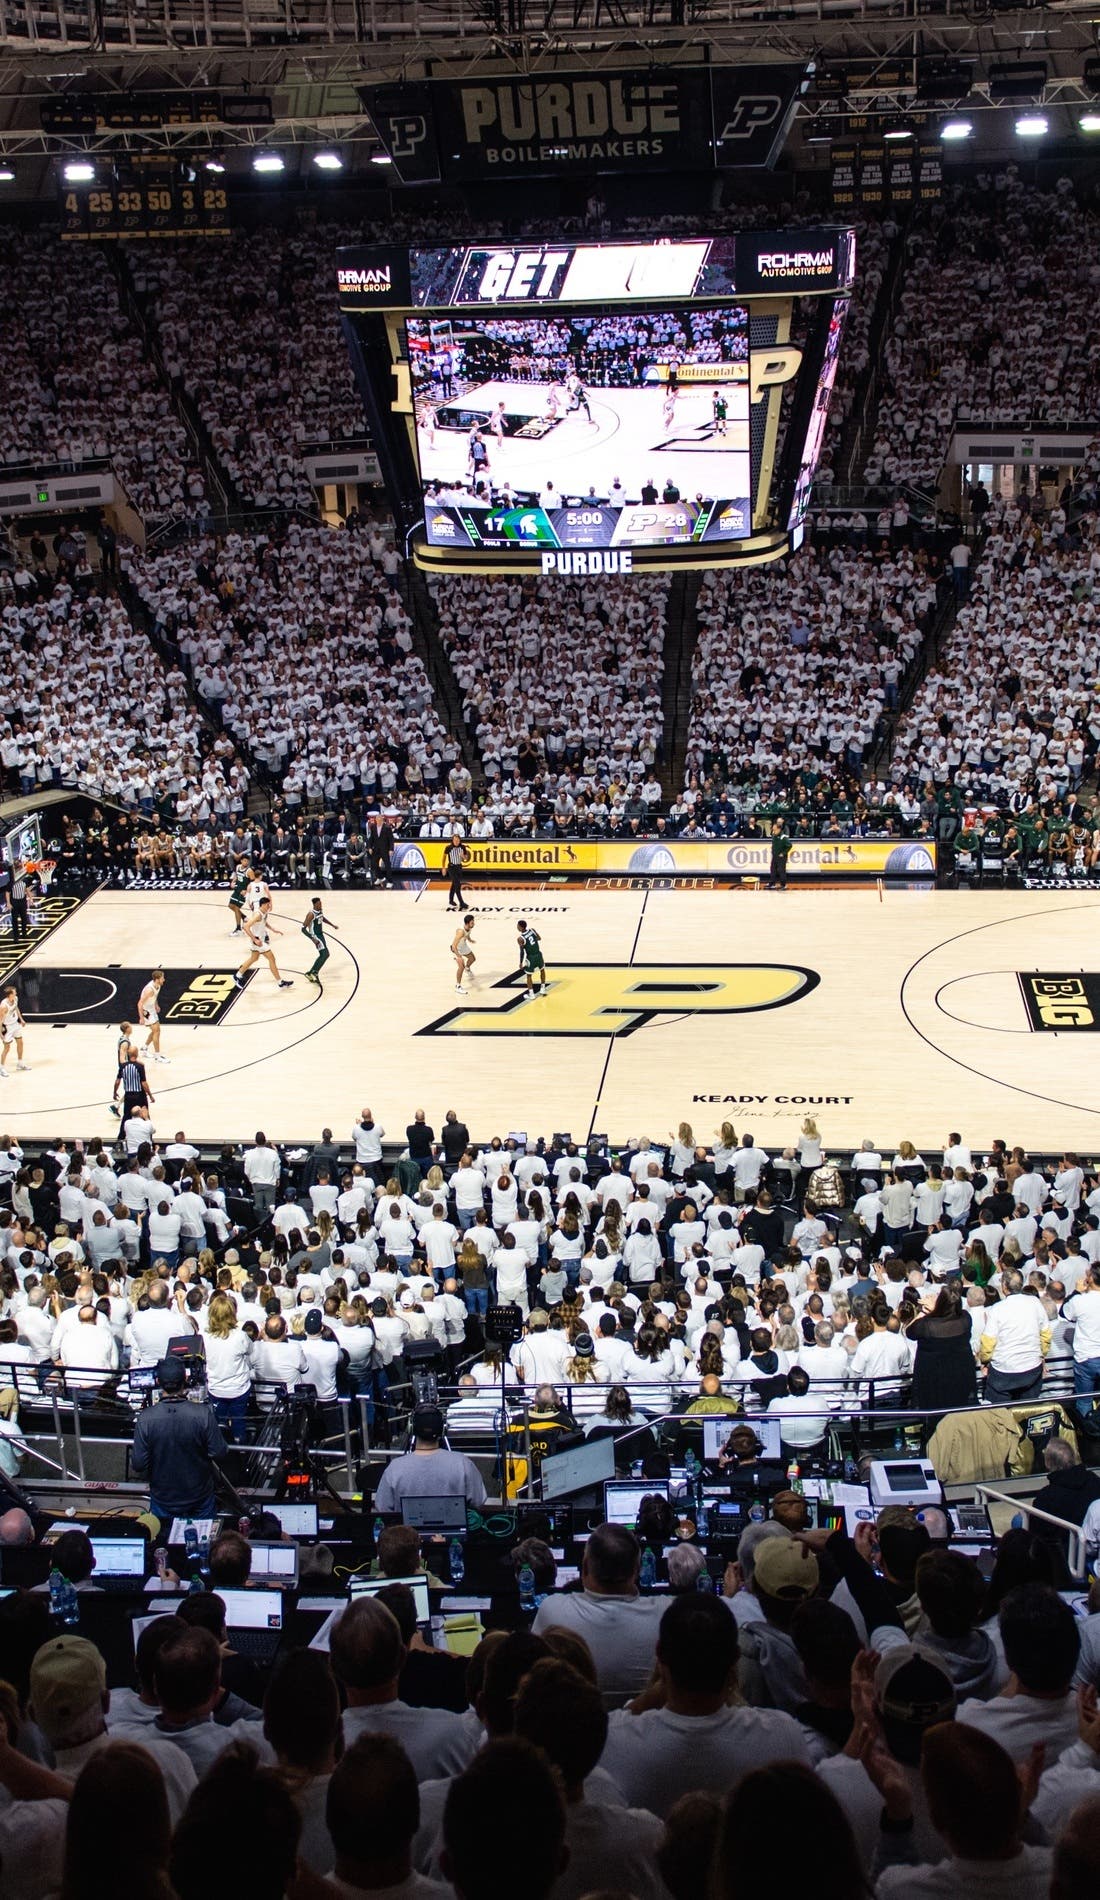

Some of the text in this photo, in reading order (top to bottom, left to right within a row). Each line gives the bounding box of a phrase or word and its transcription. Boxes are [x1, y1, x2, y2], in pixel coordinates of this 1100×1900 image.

[461, 79, 680, 143] PURDUE
[721, 95, 782, 139] P
[389, 115, 427, 157] P
[486, 139, 664, 163] BOILERMAKERS
[65, 192, 78, 213] 4
[88, 192, 114, 213] 25
[117, 191, 142, 212] 33
[146, 190, 172, 211] 50
[181, 190, 194, 210] 3
[203, 189, 227, 209] 23
[892, 190, 912, 200] 1932
[921, 188, 941, 198] 1934
[757, 248, 833, 272] ROHRMAN
[478, 252, 569, 298] GET
[761, 267, 815, 277] AUTOMOTIVE
[363, 284, 391, 292] GROUP
[667, 366, 735, 377] ontinental
[484, 517, 505, 531] 17
[566, 511, 603, 526] 5:00
[664, 513, 687, 528] 28
[541, 551, 632, 575] PURDUE
[461, 845, 560, 867] ontinental
[727, 845, 839, 868] Contental
[128, 879, 216, 888] PURDUE
[585, 878, 715, 890] PURDUE
[165, 974, 237, 1018] BIG
[1031, 978, 1094, 1027] BIG
[692, 1095, 854, 1104] KEADY COURT
[1026, 1412, 1055, 1436] P
[84, 1481, 119, 1489] GUARD
